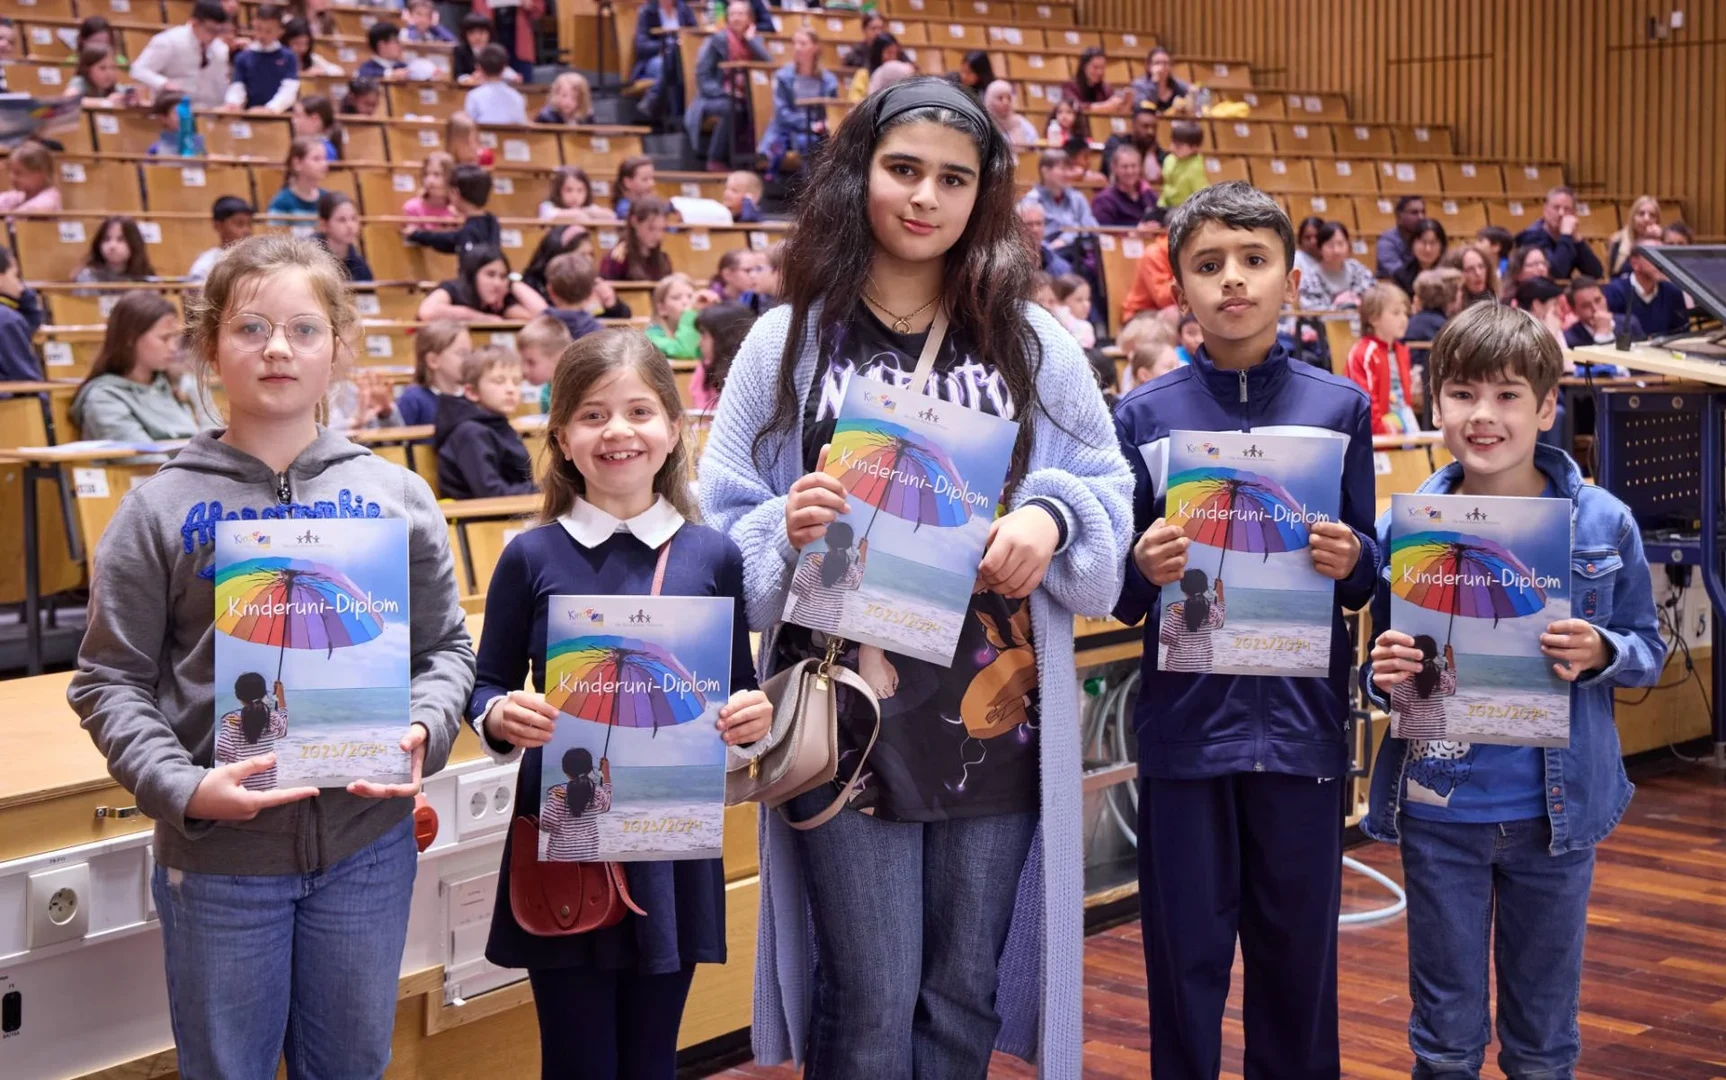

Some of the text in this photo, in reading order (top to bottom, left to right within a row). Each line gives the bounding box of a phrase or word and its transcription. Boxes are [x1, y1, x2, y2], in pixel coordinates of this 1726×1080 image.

[839, 446, 989, 508] Kinderuni-Diplom
[1178, 498, 1329, 529] Kinderuni-Diplom
[1403, 564, 1561, 594] Kinderuni-Diplom
[228, 591, 399, 620] Kinderuni-Diplom
[864, 603, 942, 632] 2023/2024
[1232, 635, 1311, 651] 2023/2024
[559, 667, 720, 699] Kinderuni-Diplom
[1467, 703, 1548, 721] 2023/2024
[300, 742, 388, 760] 2023/2024
[622, 818, 703, 834] 2023/2024
